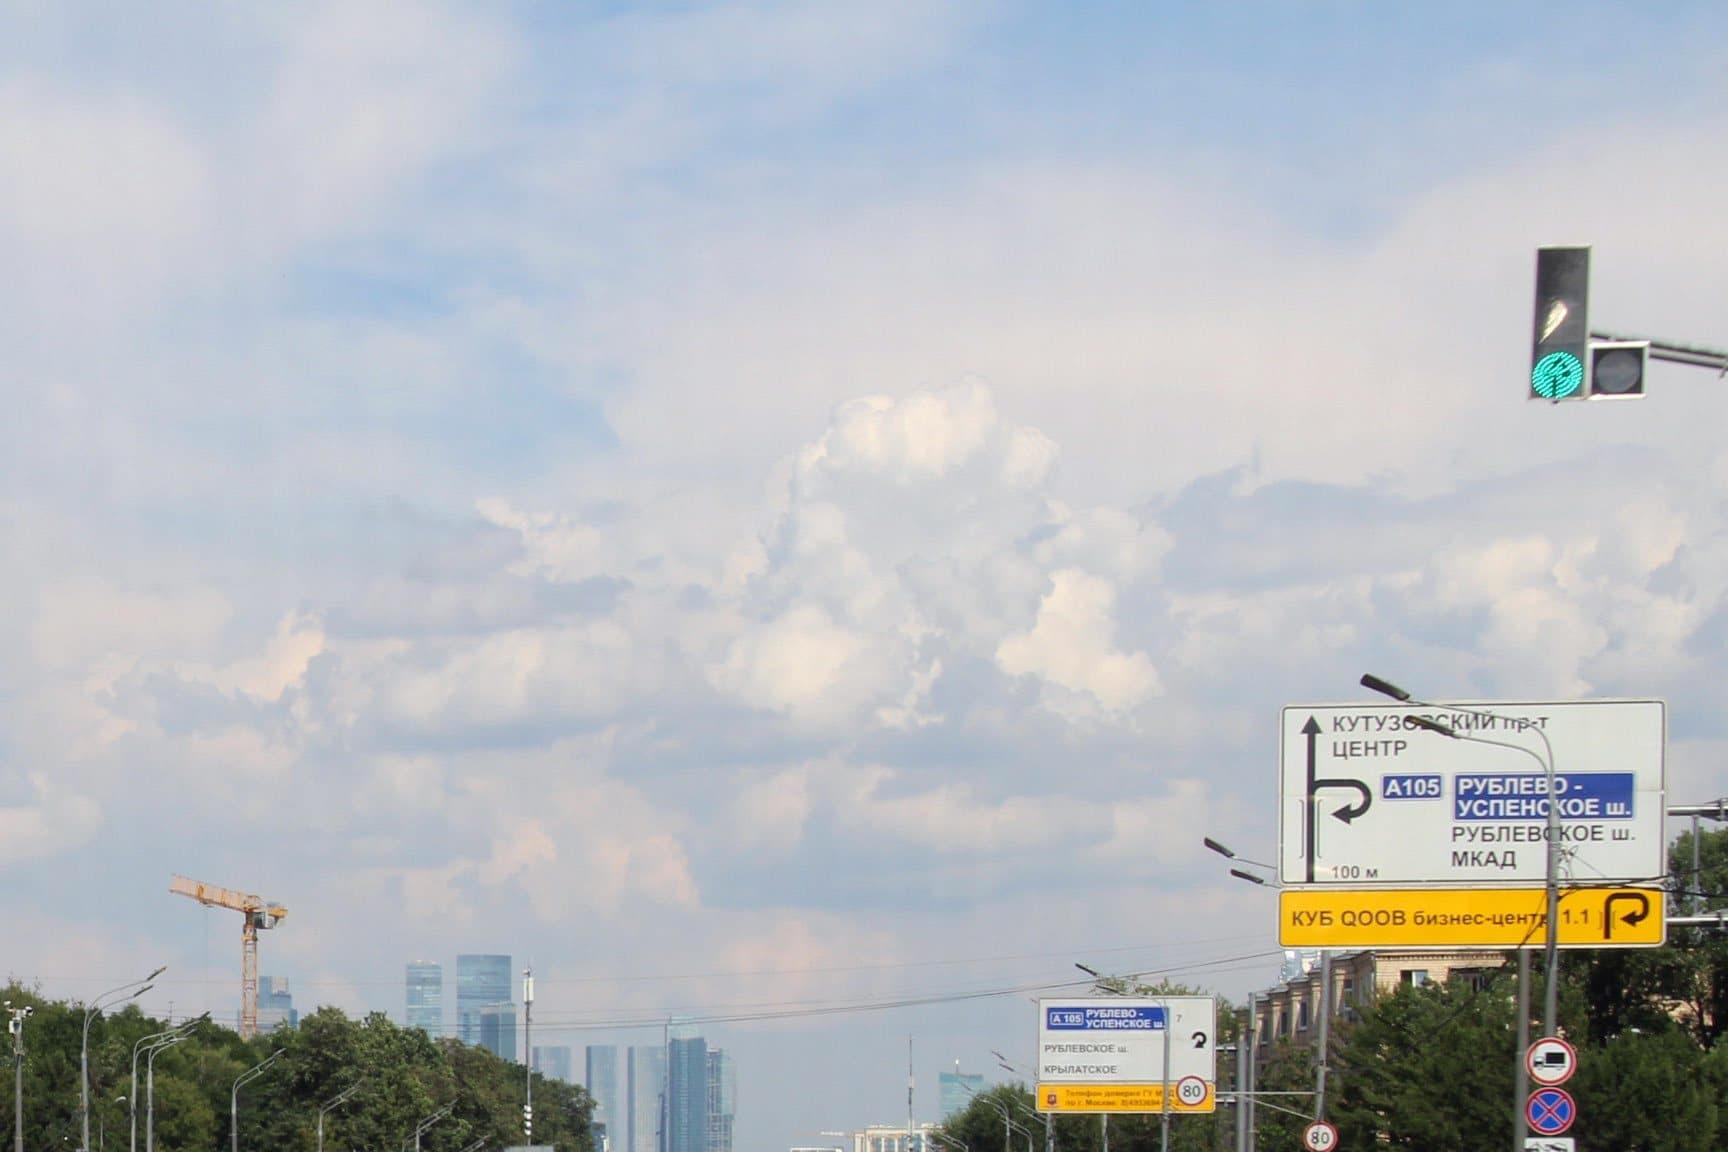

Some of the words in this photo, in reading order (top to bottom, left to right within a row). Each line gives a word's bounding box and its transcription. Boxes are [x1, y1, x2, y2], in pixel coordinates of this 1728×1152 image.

[1333, 710, 1496, 732] КУТУЗОСКИЙ
[1504, 716, 1549, 733] пр-т
[1333, 741, 1407, 759] ЦЕНТР
[1385, 777, 1440, 796] А105
[1458, 777, 1569, 796] РУБЛЕВО
[1606, 802, 1632, 816] ш.
[1612, 828, 1636, 841] ш.
[1452, 850, 1517, 869] МКАД
[1332, 866, 1360, 879] 100
[1366, 869, 1379, 879] м
[1292, 911, 1334, 926] КУБ
[1563, 909, 1589, 924] 1.1
[1063, 1014, 1082, 1023] 105
[1086, 1009, 1137, 1018] РУБЛЕВО
[1086, 1019, 1152, 1028] УСПЕНСКОЕ
[1044, 1044, 1115, 1053] РУБЛЕВСКОЕ
[1044, 1065, 1118, 1074] КРЫЛАТСКОЕ
[1183, 1085, 1202, 1098] 80
[1311, 1131, 1330, 1144] 80
